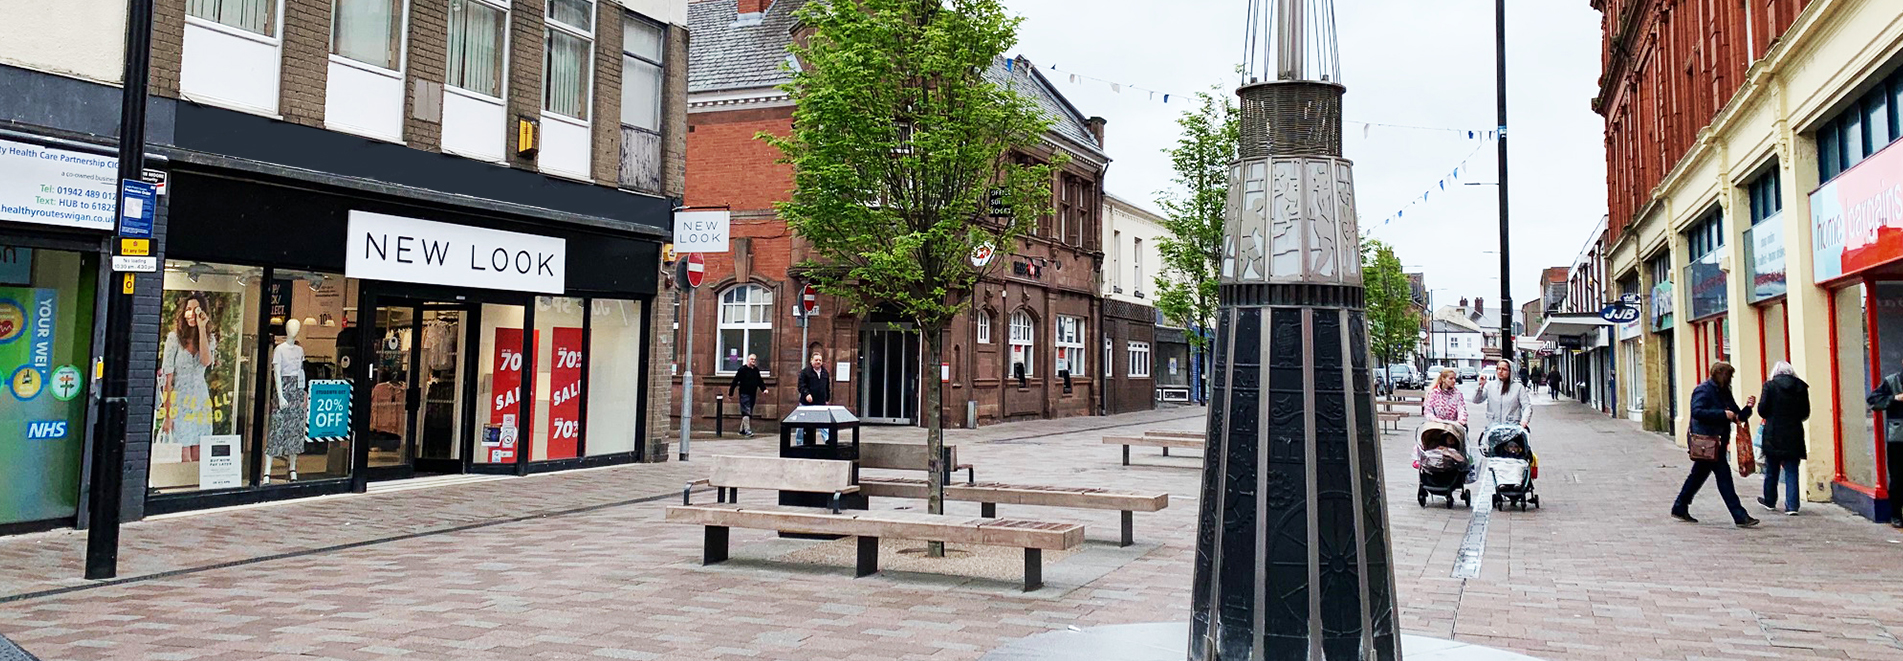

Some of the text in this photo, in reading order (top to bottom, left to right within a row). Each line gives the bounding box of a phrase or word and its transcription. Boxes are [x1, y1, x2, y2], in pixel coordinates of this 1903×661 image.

[9, 147, 38, 158] Health
[40, 151, 58, 161] Care
[60, 154, 106, 169] Partnership
[40, 184, 54, 194] Tel:
[57, 186, 83, 197] 01942
[85, 190, 100, 199] 489
[35, 196, 56, 206] Text:
[59, 199, 78, 208] HUB
[80, 201, 89, 210] to
[1816, 179, 1903, 251] home bargains
[683, 221, 718, 231] NEW
[679, 233, 721, 244] LOOK
[365, 232, 554, 277] NEW LOOK
[37, 298, 53, 338] YOUR
[1604, 308, 1636, 320] JJB
[316, 398, 344, 412] 20%
[315, 412, 343, 428] OFF
[28, 423, 67, 439] NHS
